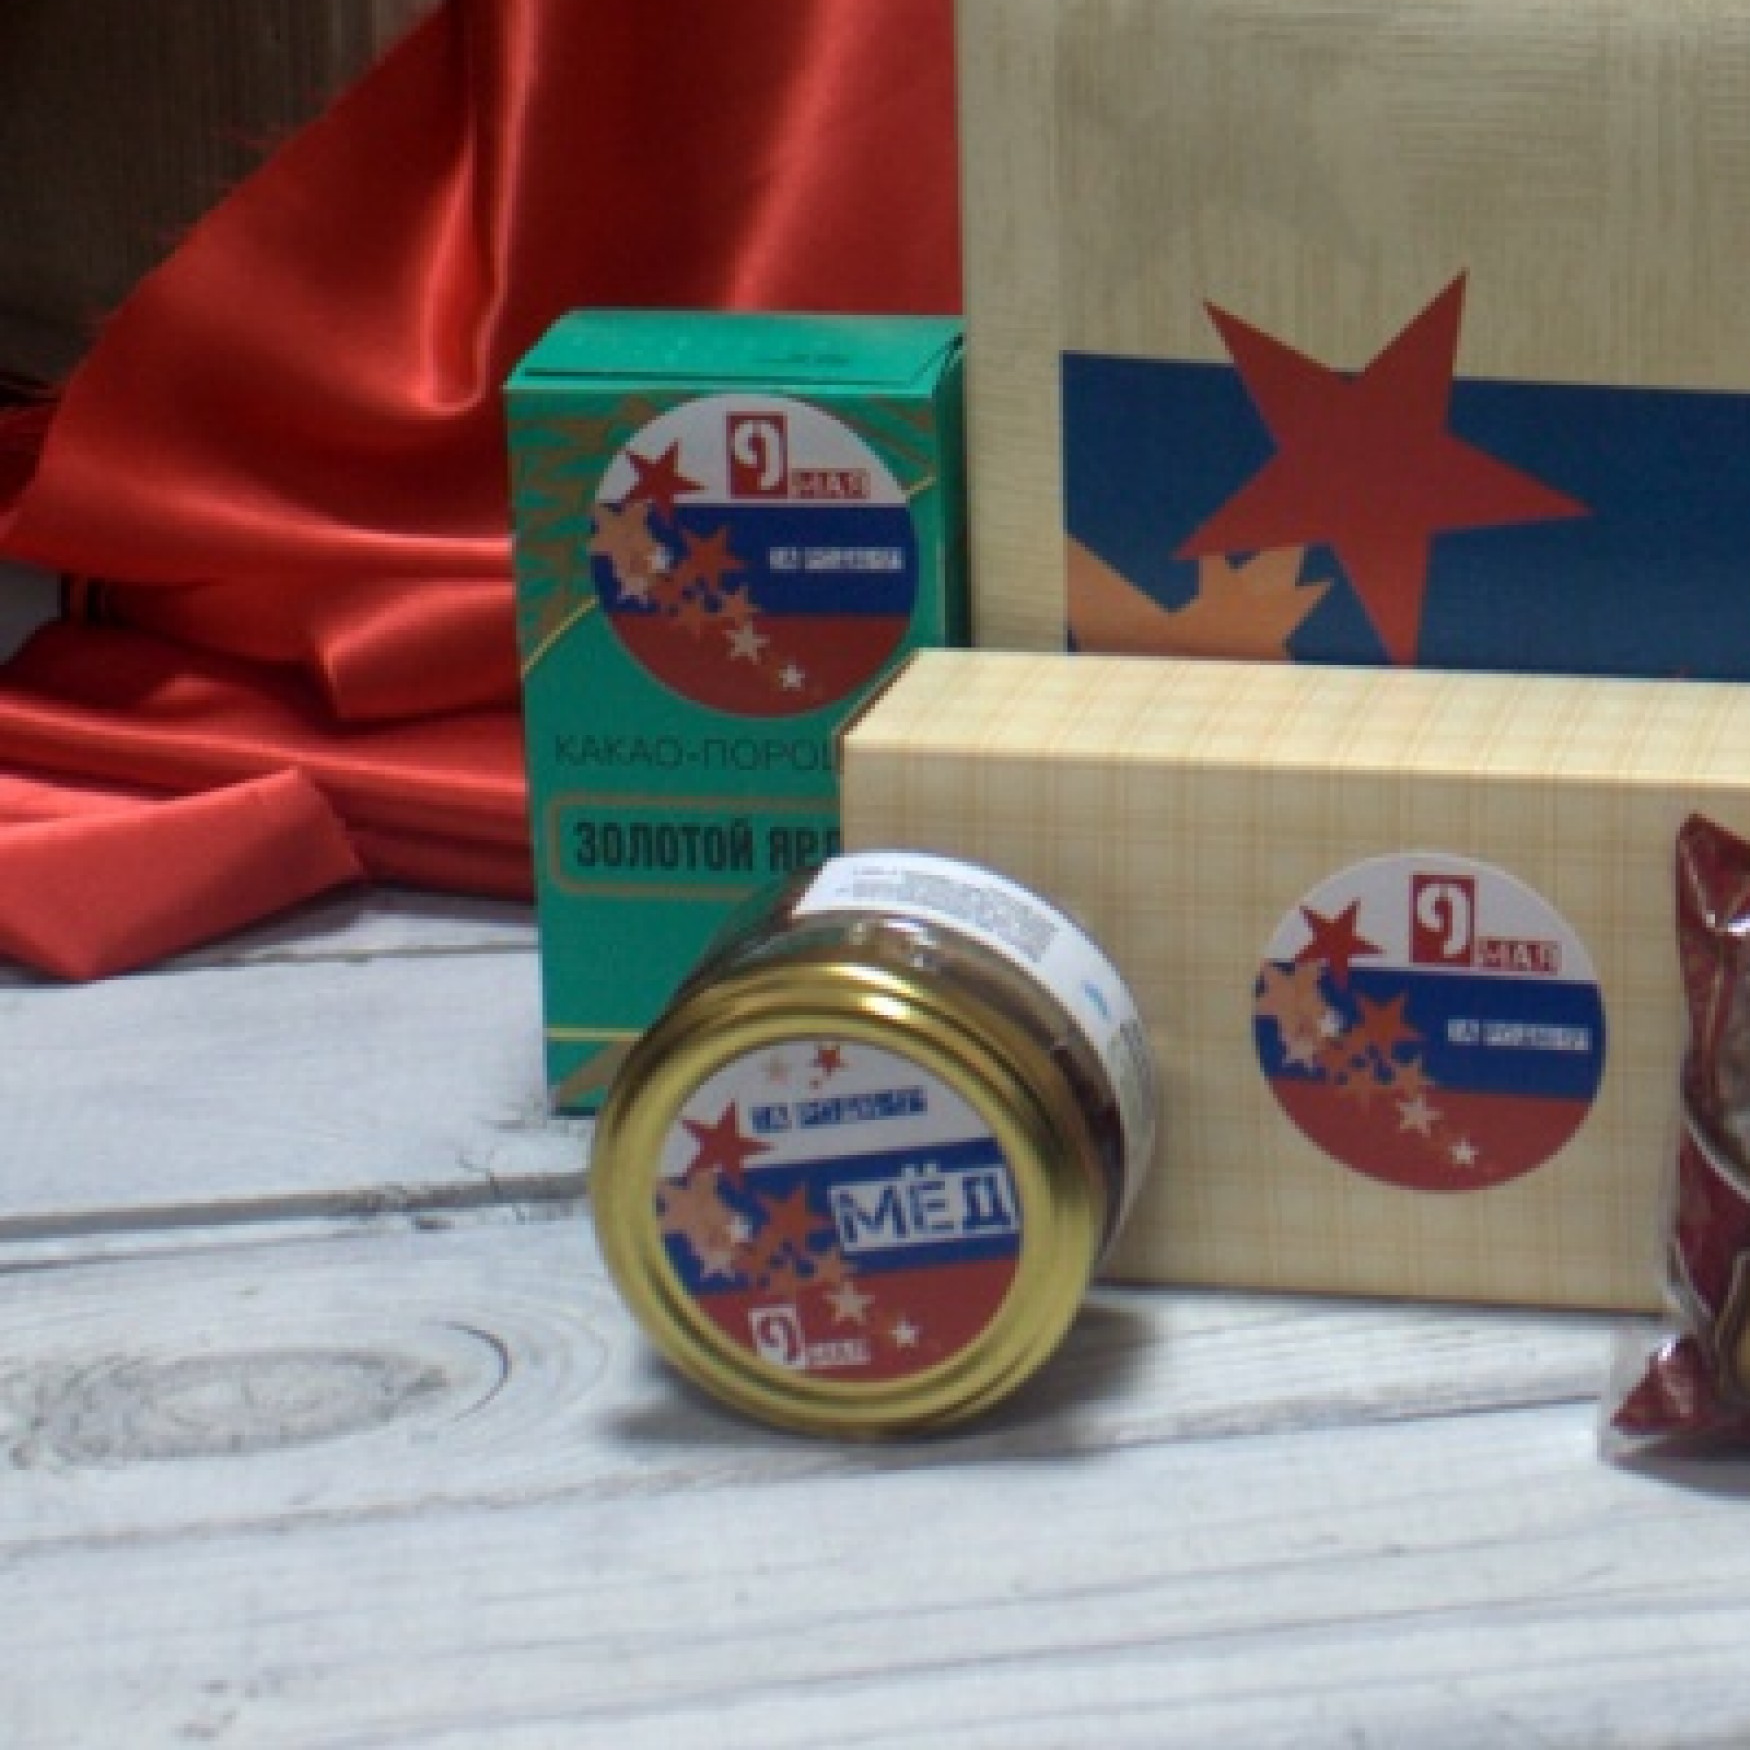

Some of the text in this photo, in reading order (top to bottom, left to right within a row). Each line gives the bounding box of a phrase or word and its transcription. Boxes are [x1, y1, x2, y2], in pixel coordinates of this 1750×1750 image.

[734, 418, 780, 491] 9
[573, 817, 754, 872] ЗОЛОТОЙ
[1416, 882, 1468, 959] 9
[838, 1162, 1011, 1244] МЁД
